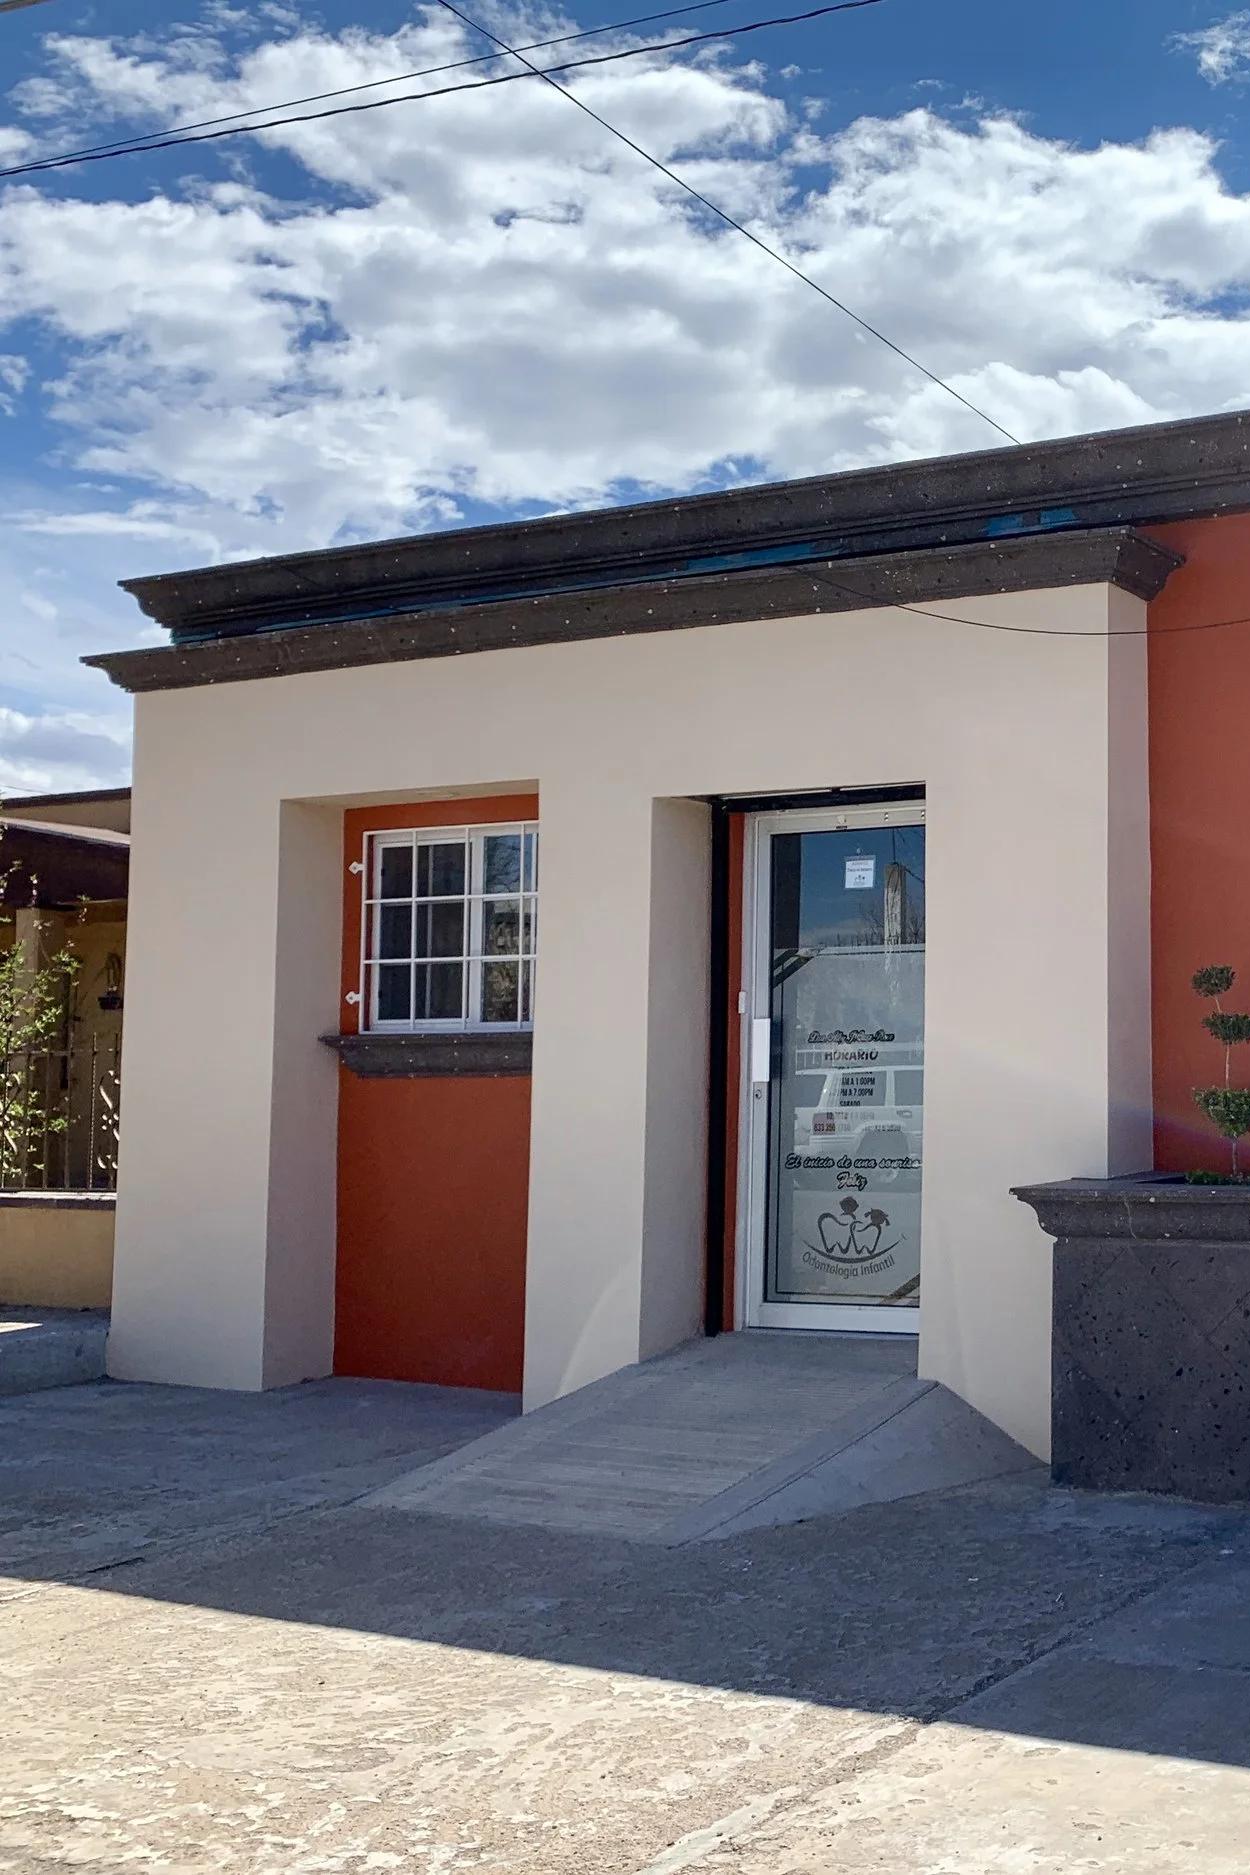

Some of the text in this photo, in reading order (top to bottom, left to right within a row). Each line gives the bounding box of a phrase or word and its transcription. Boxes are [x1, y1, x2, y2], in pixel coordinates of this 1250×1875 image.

[824, 1050, 879, 1061] HORARIO
[785, 1153, 802, 1169] El
[803, 1156, 835, 1168] inicio
[837, 1154, 852, 1168] de
[854, 1158, 877, 1168] una
[861, 1254, 895, 1275] Infantil
